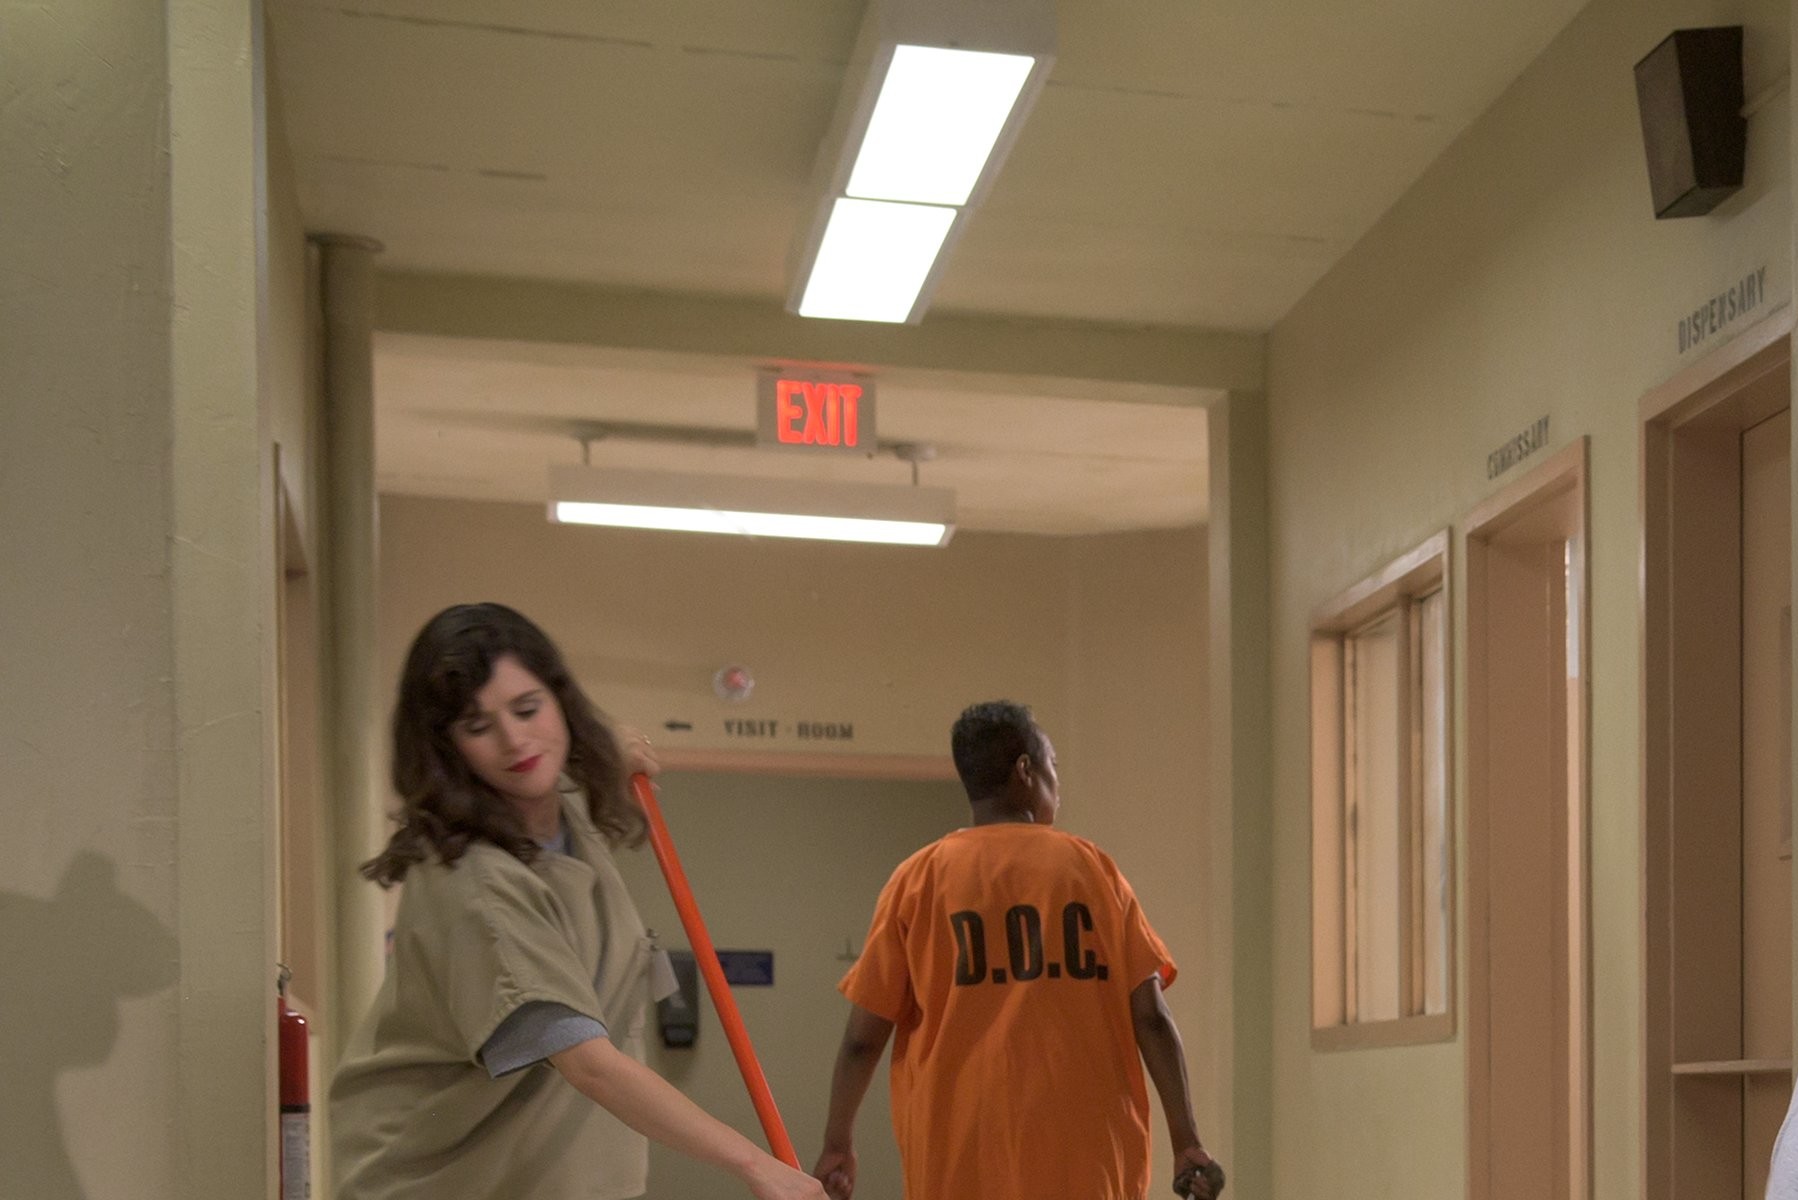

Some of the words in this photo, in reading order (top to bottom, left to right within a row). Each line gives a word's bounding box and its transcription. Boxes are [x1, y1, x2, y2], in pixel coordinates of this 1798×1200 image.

[1678, 265, 1766, 355] DISPENSARY
[776, 380, 863, 447] EXIT
[724, 719, 777, 738] VISIT
[797, 721, 854, 741] ROOM
[950, 901, 1109, 986] D.O.C.
